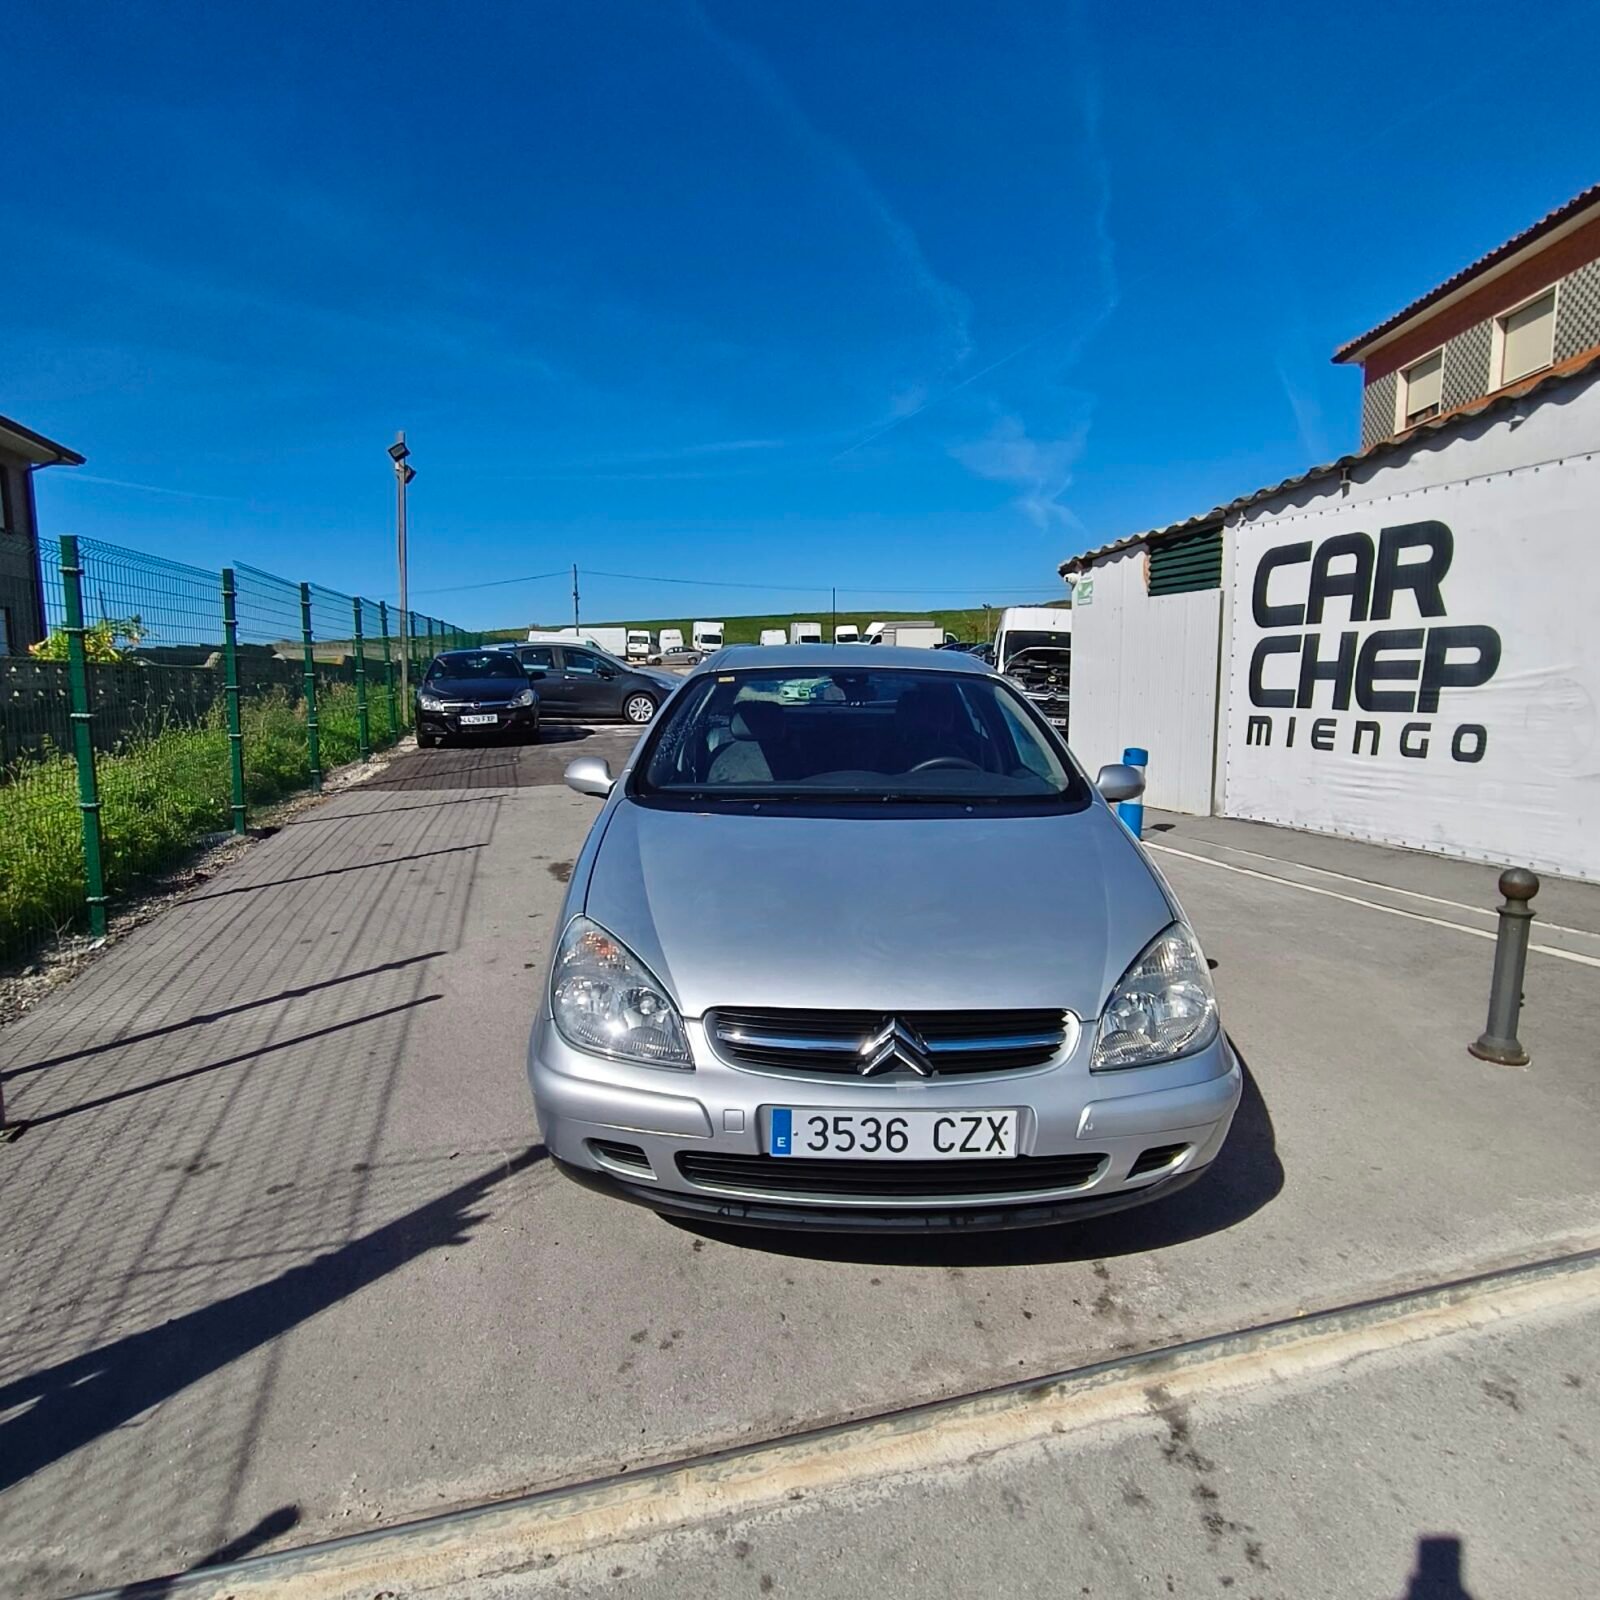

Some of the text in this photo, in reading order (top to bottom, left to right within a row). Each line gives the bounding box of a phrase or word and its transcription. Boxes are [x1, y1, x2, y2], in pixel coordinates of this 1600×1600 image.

[1251, 520, 1454, 628] CAR
[1248, 625, 1501, 714] CHEP
[1246, 716, 1488, 763] MIENGO
[777, 1137, 786, 1147] E
[807, 1116, 1008, 1153] 3536 CZX
